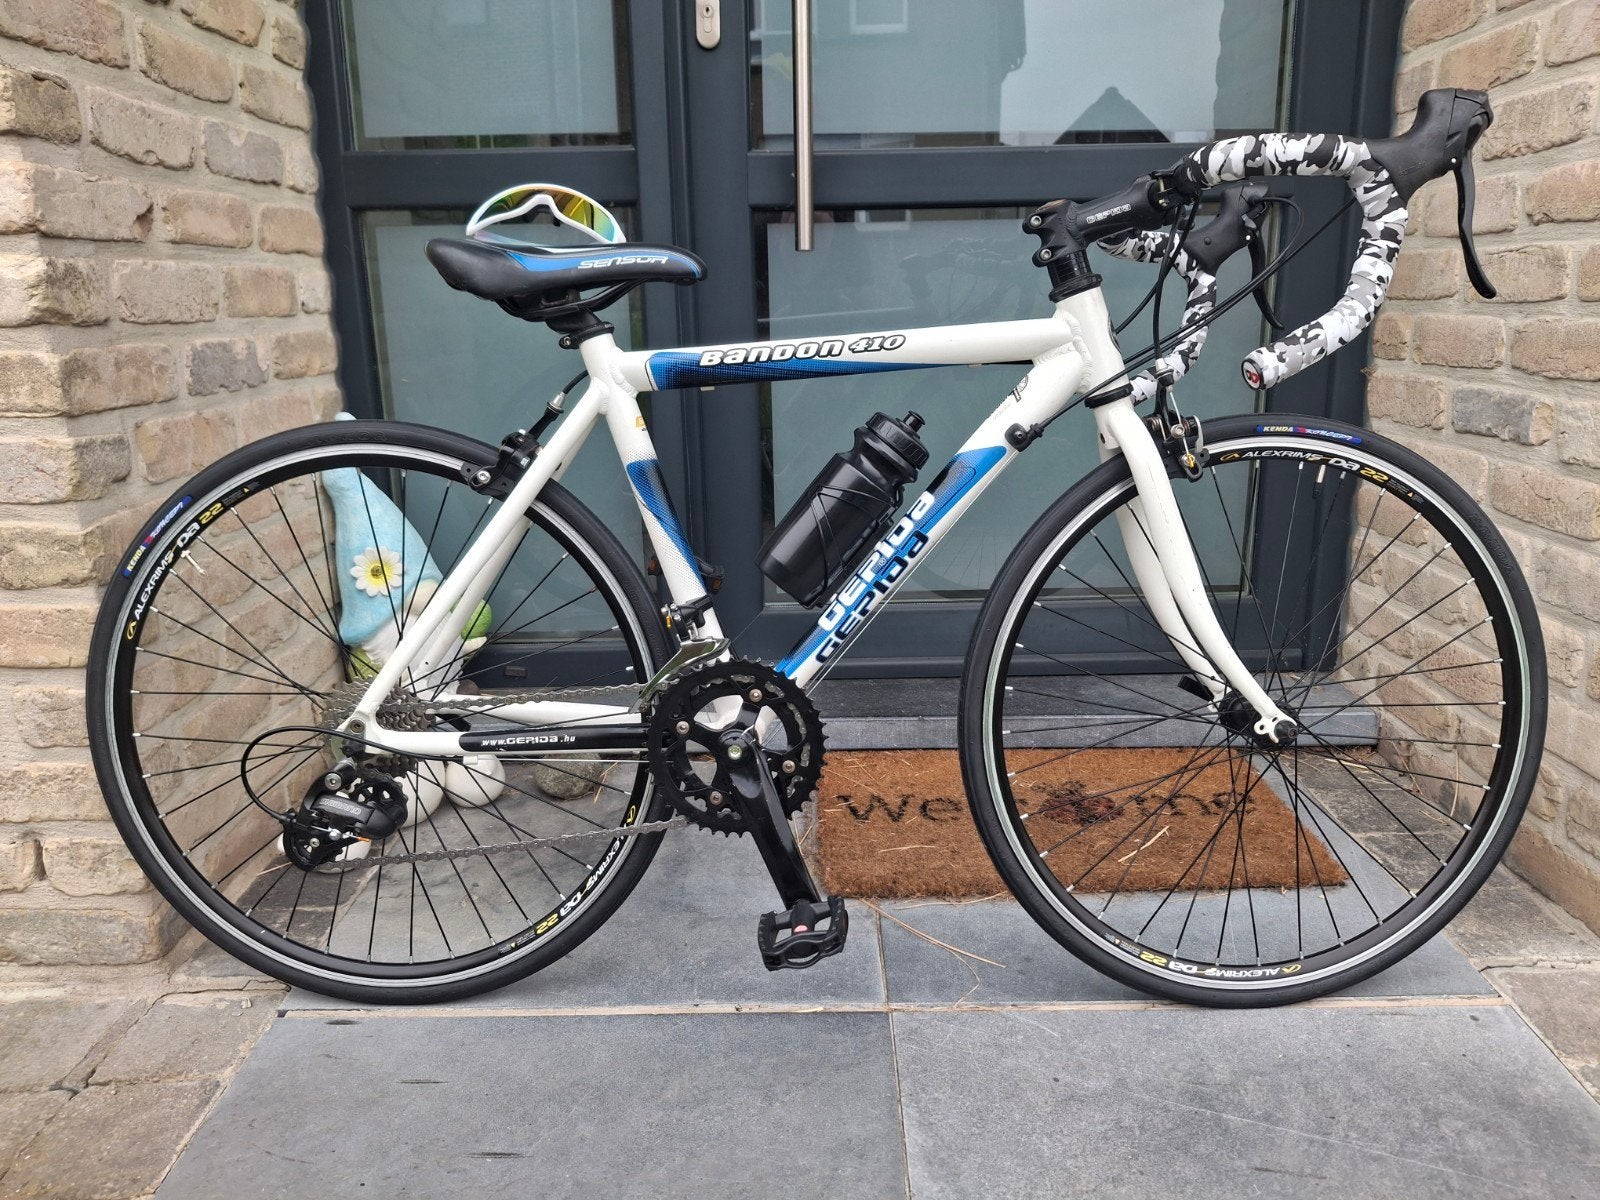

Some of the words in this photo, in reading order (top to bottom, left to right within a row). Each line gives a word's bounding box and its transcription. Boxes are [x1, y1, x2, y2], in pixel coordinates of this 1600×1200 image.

[577, 255, 669, 269] SENSOR
[848, 334, 906, 354] 410
[1263, 425, 1294, 433] KENDA
[1242, 450, 1323, 462] ALEXRIMS
[126, 545, 147, 572] KENDA
[134, 549, 174, 620] ALEXRIMS
[1204, 966, 1281, 978] ALEXRIMS
